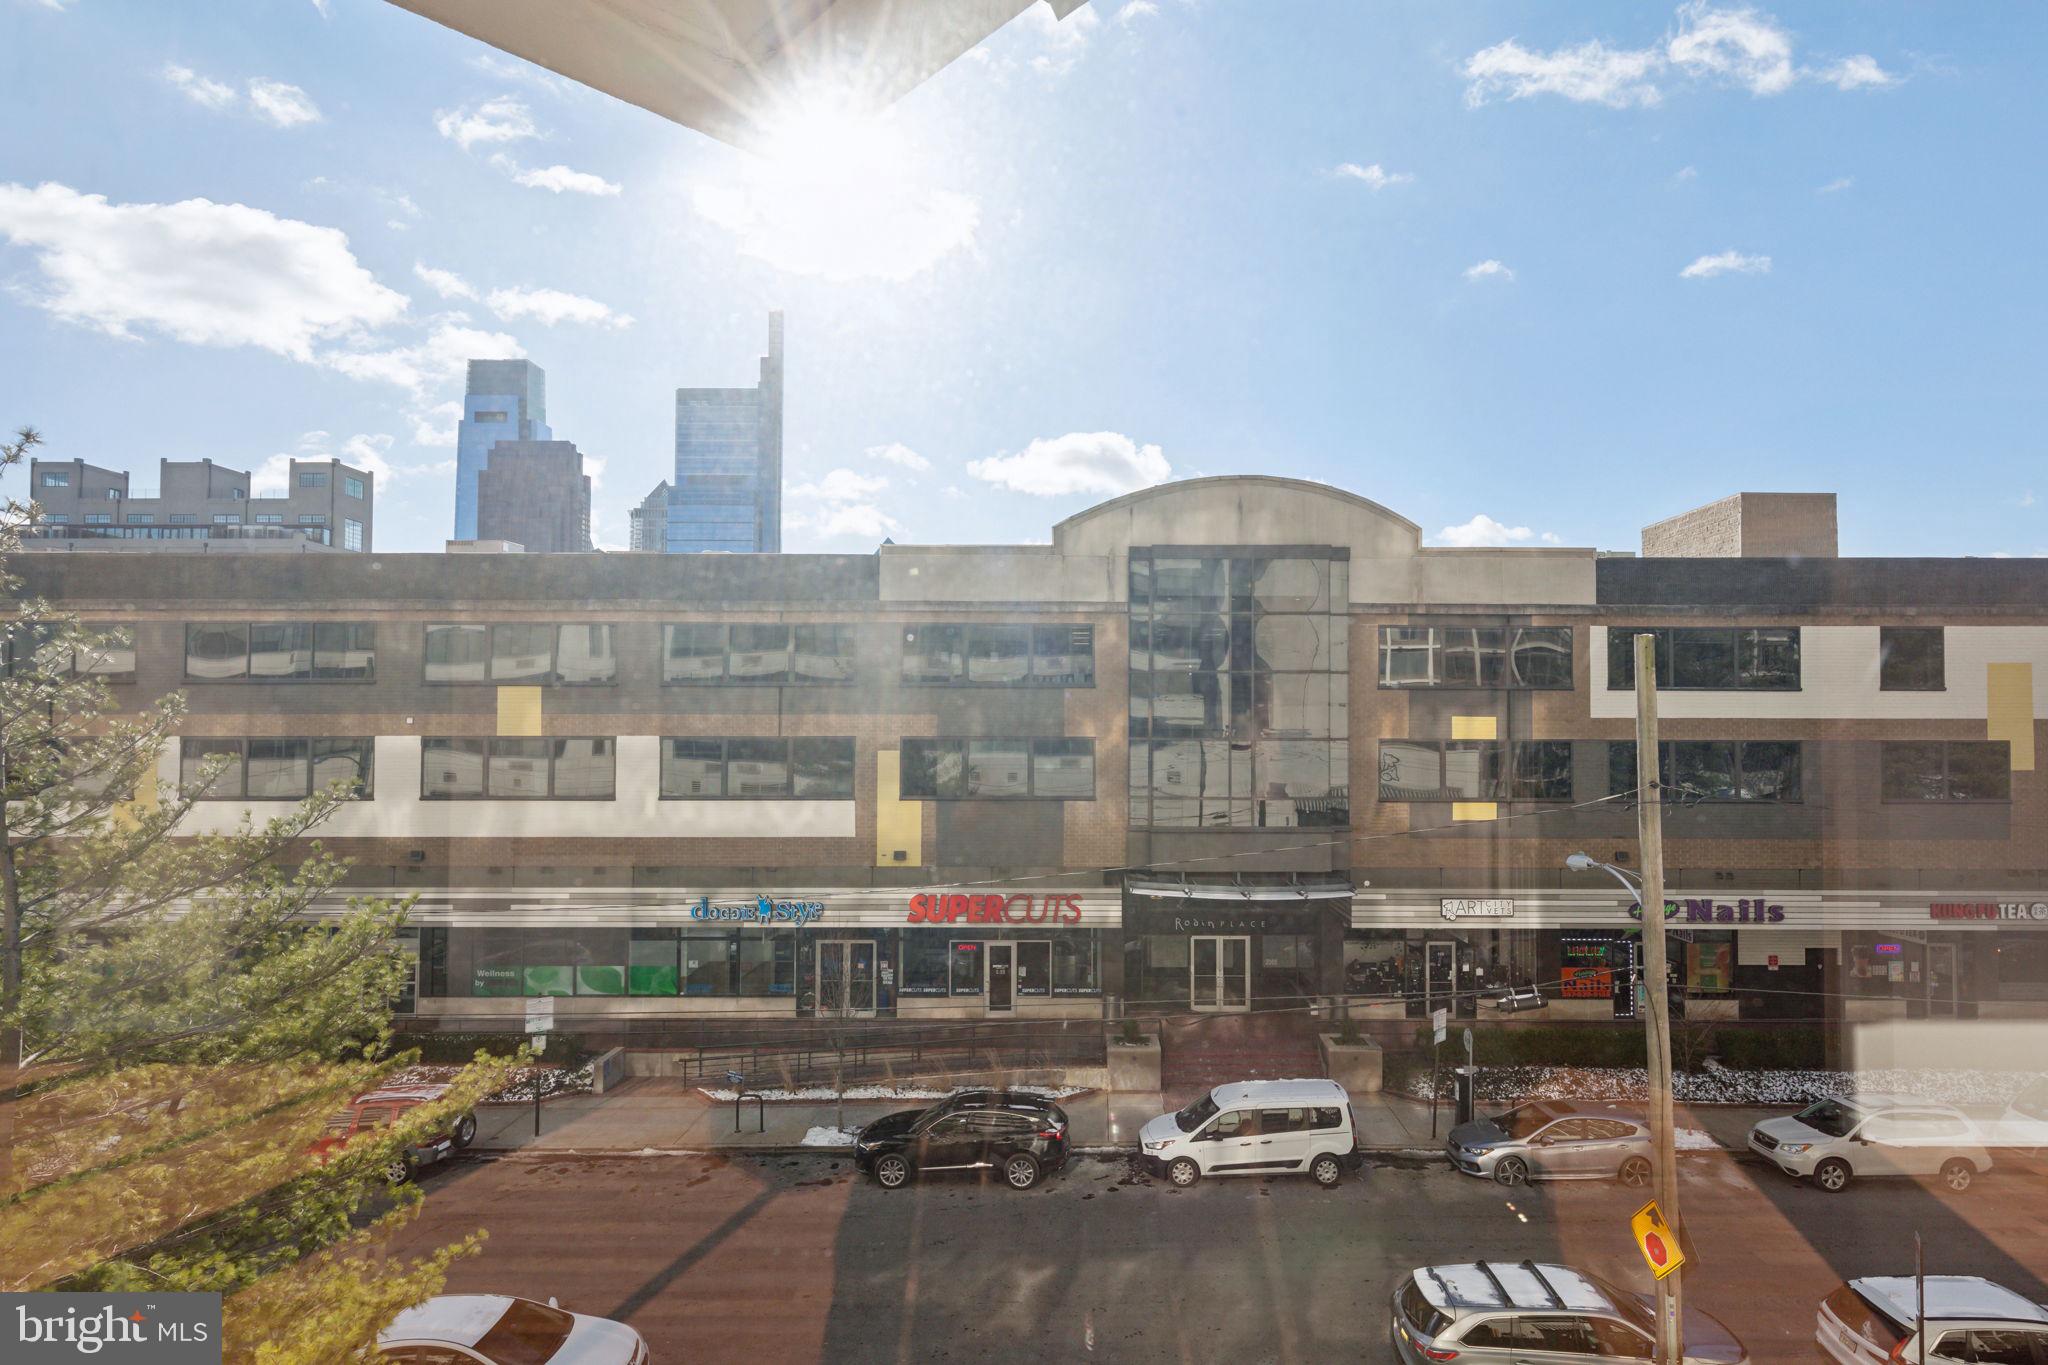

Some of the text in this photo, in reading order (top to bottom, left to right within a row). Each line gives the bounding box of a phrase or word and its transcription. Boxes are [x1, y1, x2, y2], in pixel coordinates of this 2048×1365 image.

[907, 893, 1083, 924] SUPERCUTS
[1456, 900, 1485, 914] ART
[1685, 899, 1785, 922] Nails
[1999, 904, 2027, 920] TEA
[1220, 920, 1266, 928] PLACE
[477, 969, 515, 977] Wellness
